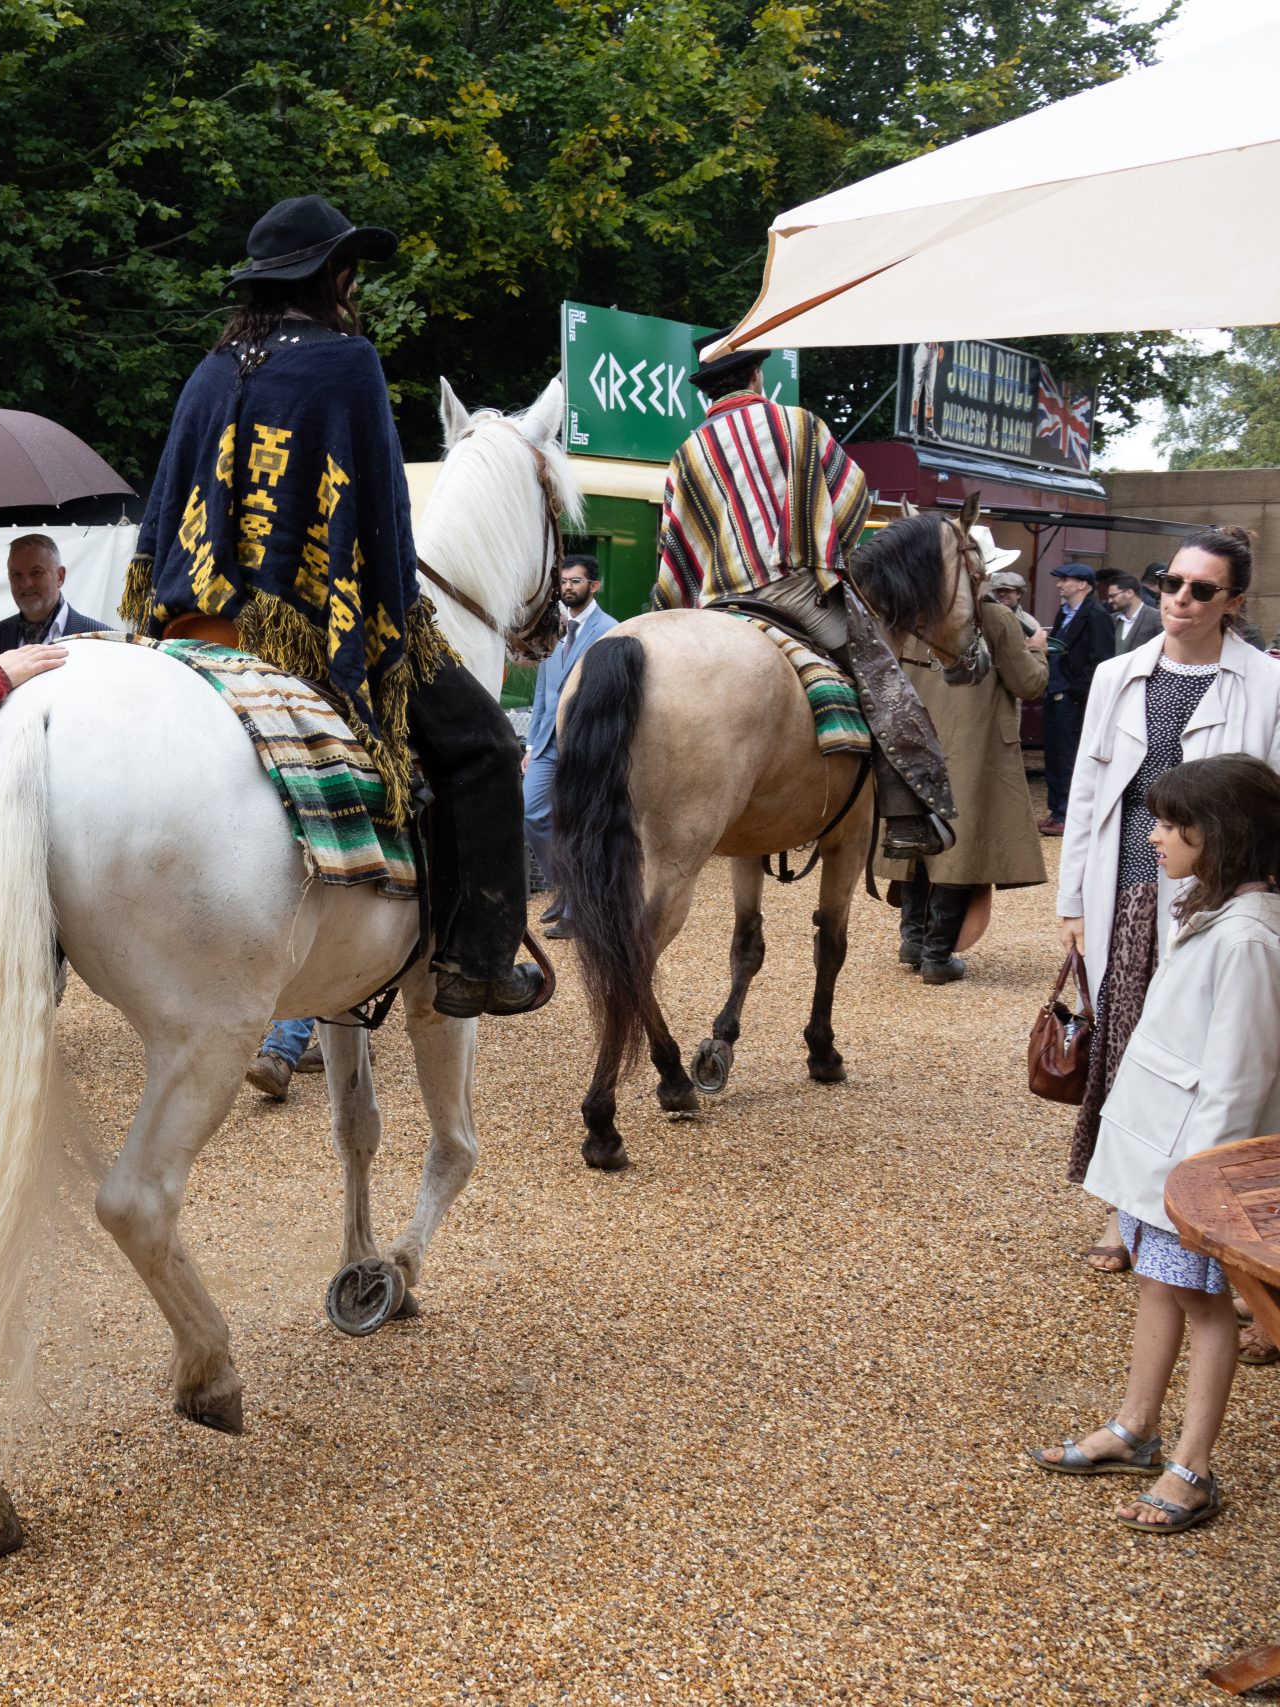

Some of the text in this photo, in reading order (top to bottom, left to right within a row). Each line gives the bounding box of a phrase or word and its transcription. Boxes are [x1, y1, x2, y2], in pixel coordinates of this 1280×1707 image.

[589, 352, 686, 419] GREEK
[947, 341, 1032, 412] JOHN BULL
[941, 401, 1032, 455] BURGERS & BACON
